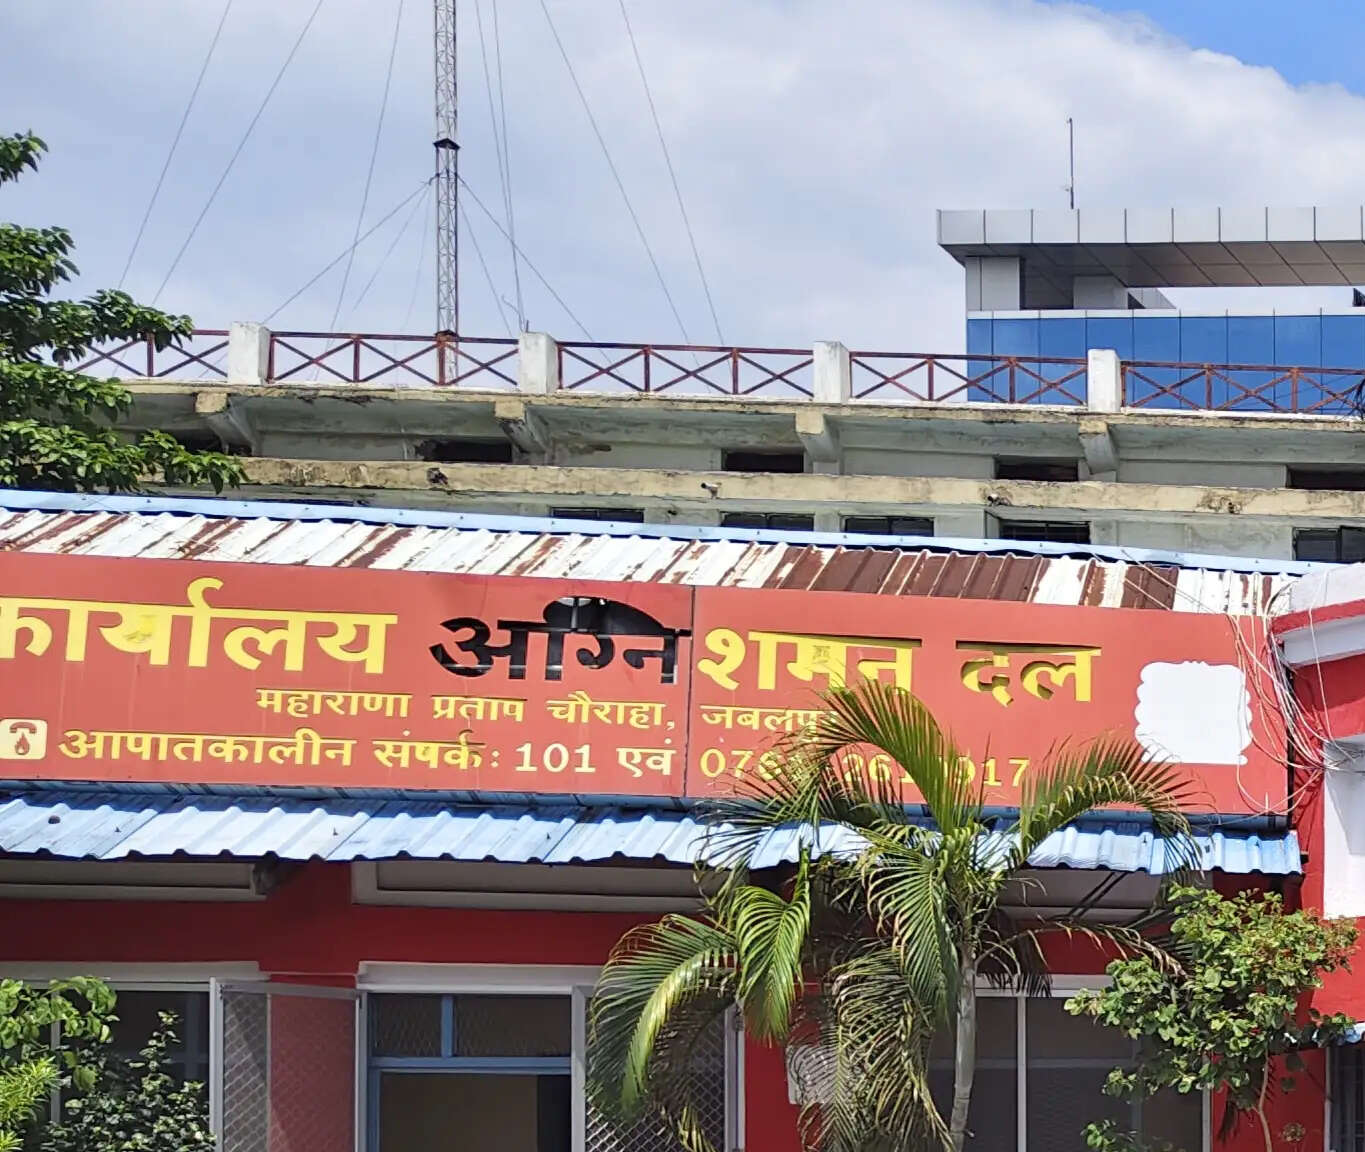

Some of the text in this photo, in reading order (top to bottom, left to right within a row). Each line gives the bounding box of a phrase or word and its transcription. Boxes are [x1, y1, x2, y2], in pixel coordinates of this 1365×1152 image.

[429, 596, 692, 683] अग्नि
[697, 628, 922, 697] शमन
[956, 640, 1101, 708] दल
[256, 688, 412, 718] महाराणा
[432, 694, 527, 721] प्रताप
[546, 691, 675, 730] चौराहा,
[58, 727, 357, 766] आपातकालीन
[515, 743, 596, 773] 101
[616, 738, 676, 777] एवं
